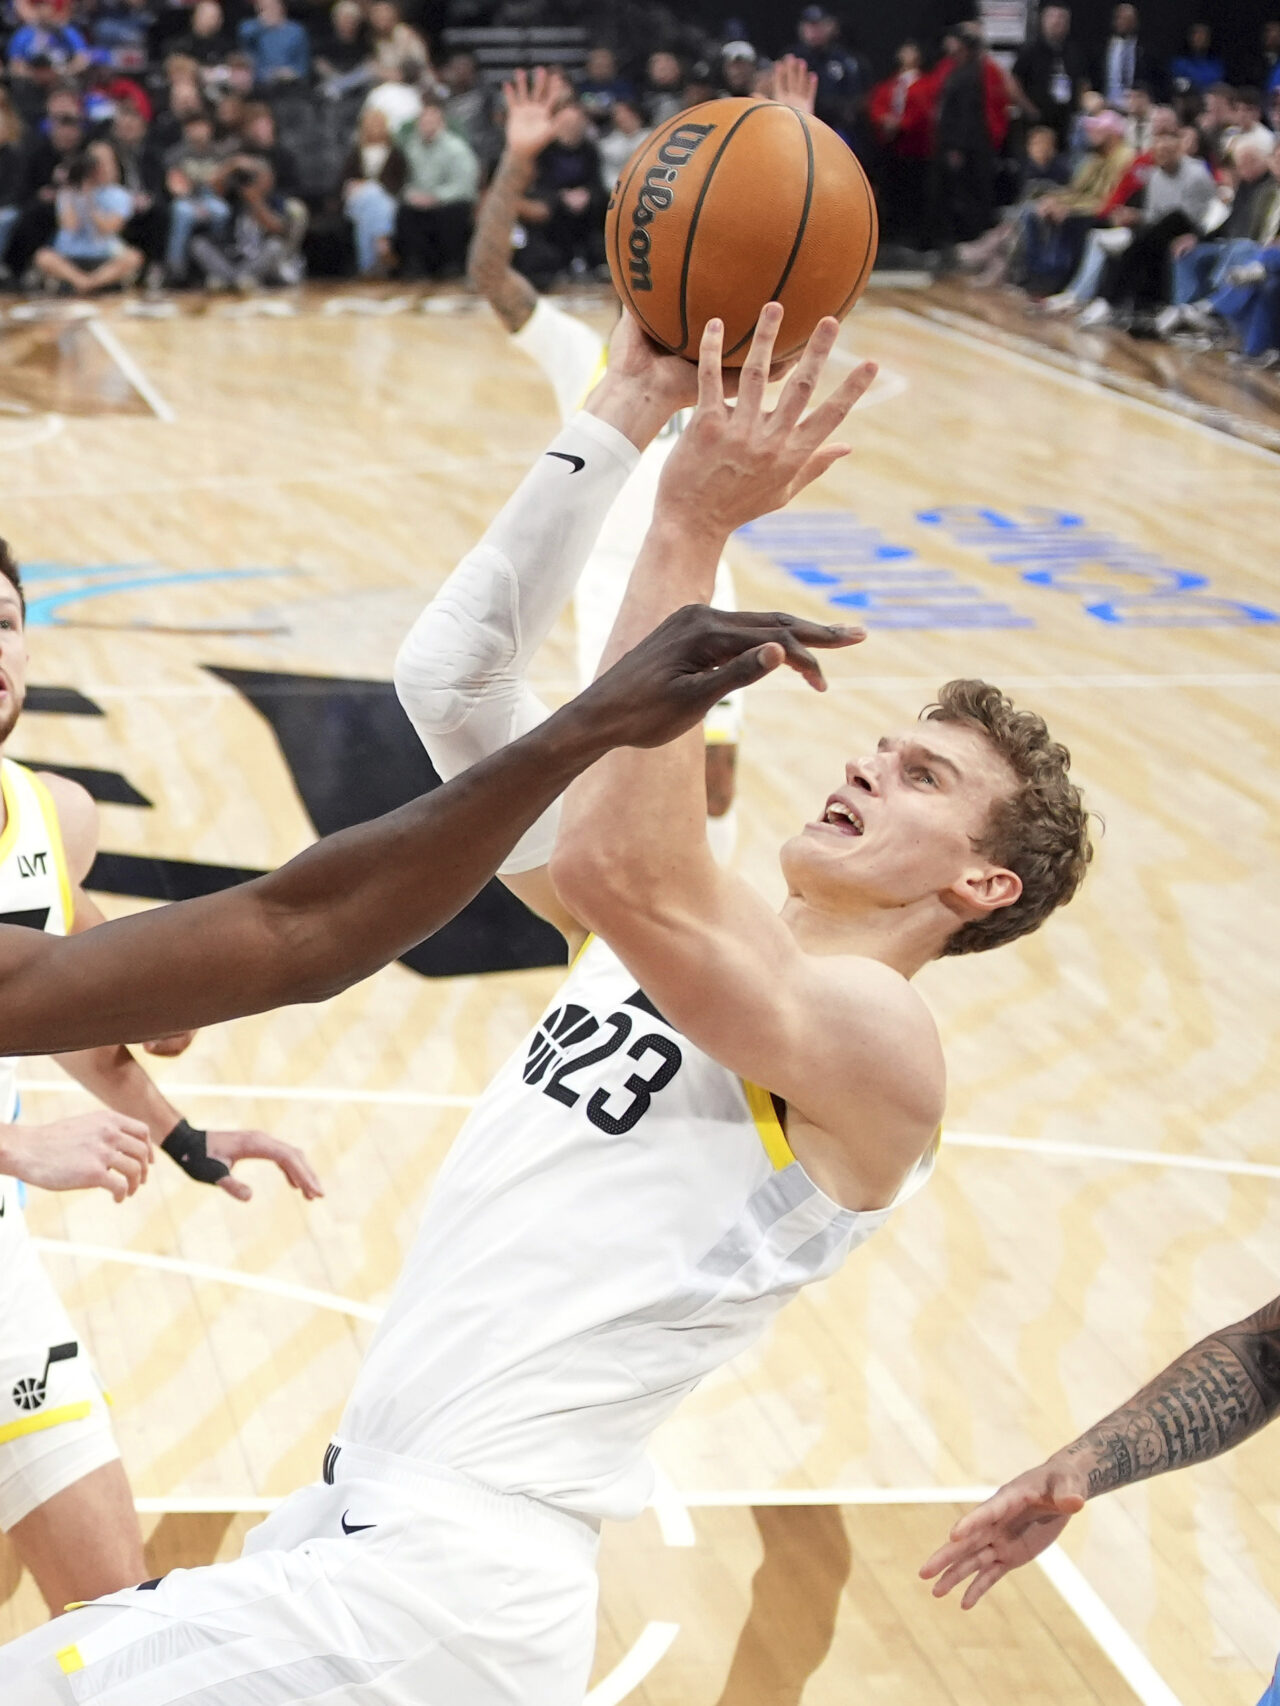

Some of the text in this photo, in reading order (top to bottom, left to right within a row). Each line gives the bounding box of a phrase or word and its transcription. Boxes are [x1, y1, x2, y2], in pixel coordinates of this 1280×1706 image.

[628, 122, 718, 291] Wilson
[17, 852, 47, 878] LVT
[542, 1011, 682, 1136] 23
